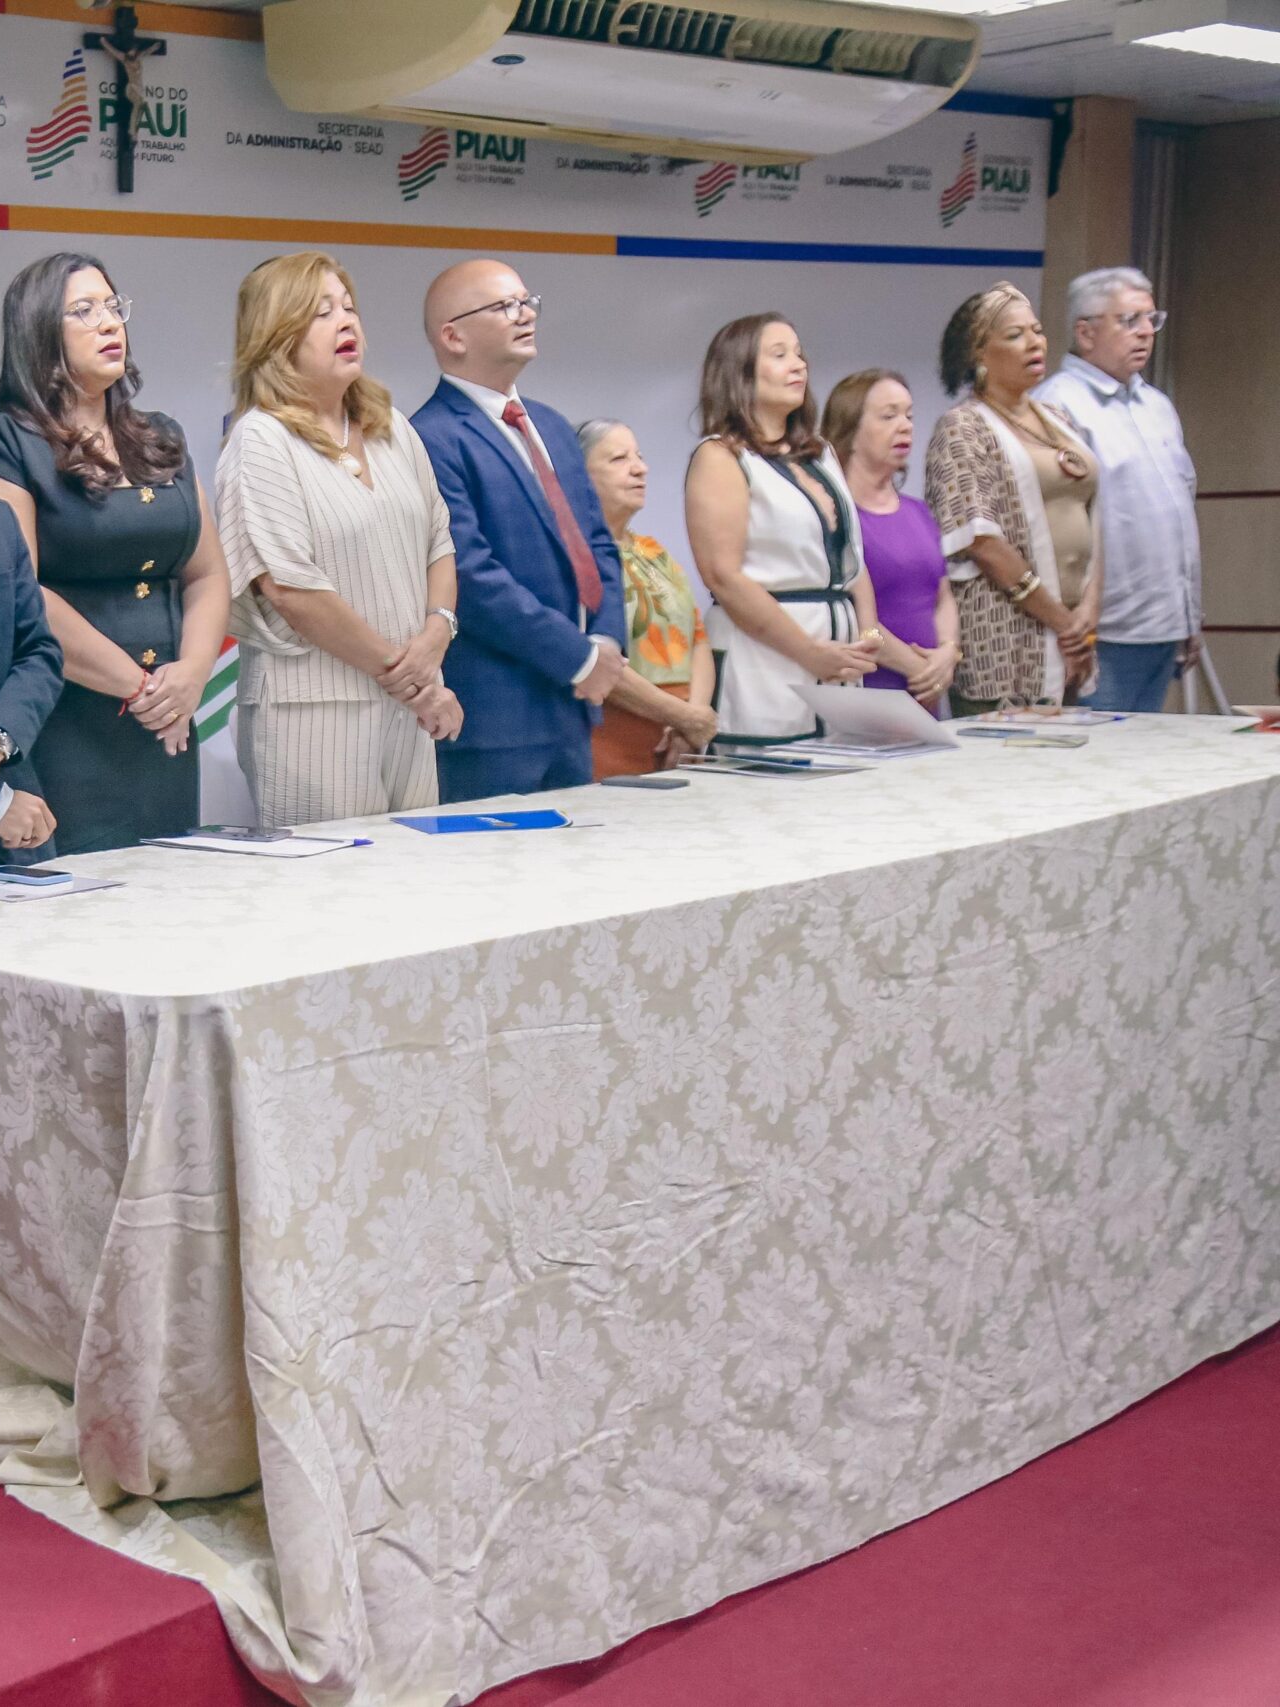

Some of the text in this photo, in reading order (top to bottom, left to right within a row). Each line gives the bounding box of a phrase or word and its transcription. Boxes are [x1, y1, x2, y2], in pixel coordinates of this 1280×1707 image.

[99, 81, 188, 101] GONO DO
[99, 97, 187, 138] PAUÍ
[317, 122, 384, 138] SECRETARIA
[141, 140, 186, 151] TRABALHO
[226, 132, 242, 144] DA
[246, 133, 342, 154] ADMINISTRAÇÃO
[354, 141, 383, 155] SEAD
[141, 152, 175, 163] FUTURO
